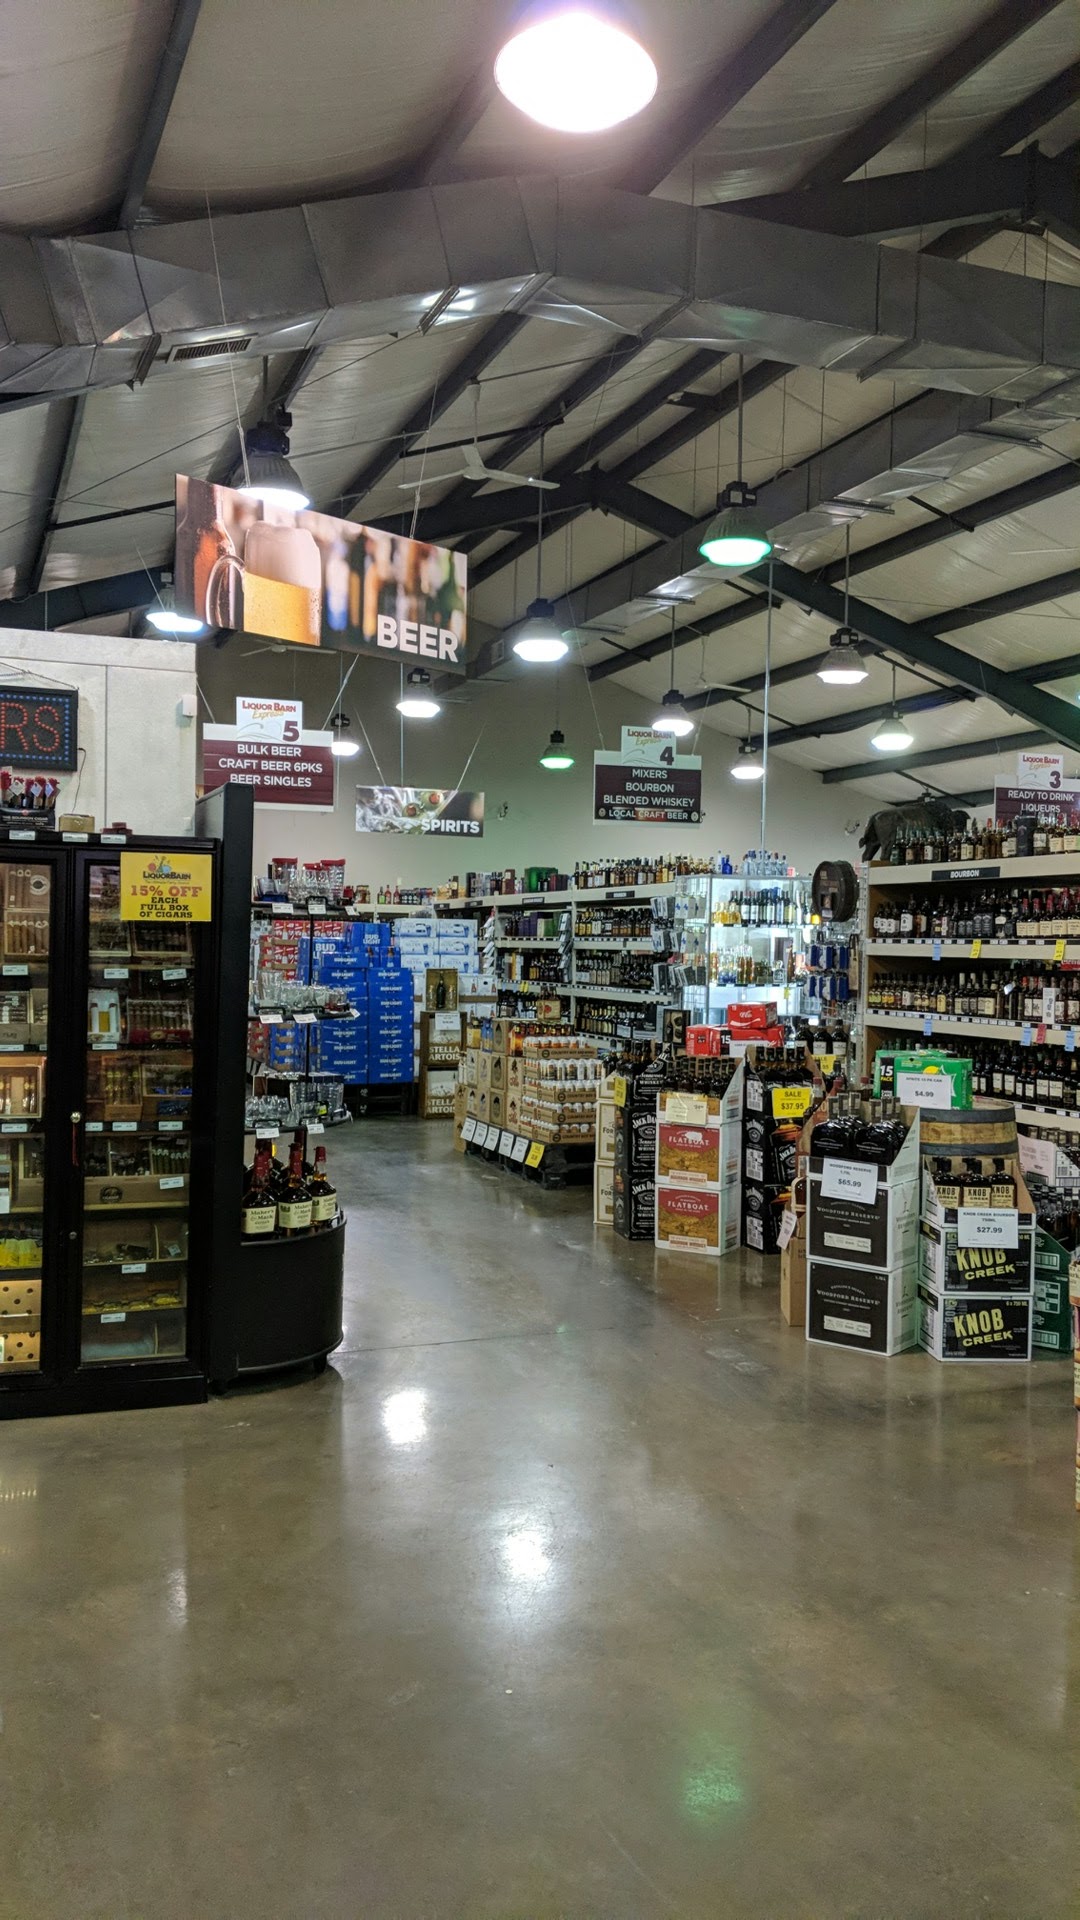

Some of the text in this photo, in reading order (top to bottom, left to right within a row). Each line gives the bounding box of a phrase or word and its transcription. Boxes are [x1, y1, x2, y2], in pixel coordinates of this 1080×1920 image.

[376, 614, 458, 662] BEER
[242, 700, 296, 712] LIQUOR BARN
[282, 720, 300, 742] 5
[237, 744, 302, 757] BULK BEER
[660, 746, 674, 766] 4
[218, 758, 322, 774] CRAFT BEER 6PKS
[632, 769, 668, 779] MIXERS
[1049, 770, 1061, 789] 3
[230, 774, 312, 788] BEER SINGLES
[626, 782, 674, 792] BOURBON
[603, 794, 695, 808] BLENDED WHISKEY
[1008, 790, 1074, 802] READY TO DRINK
[608, 809, 688, 820] LOCAL CRAFT BEER
[1021, 803, 1061, 813] LIQUEURS
[420, 818, 480, 834] SPIRITS
[950, 870, 980, 878] BOURBON
[131, 885, 202, 898] 15% OFF
[315, 943, 336, 952] BUD
[720, 1035, 731, 1044] 15
[880, 1065, 893, 1076] 15
[632, 1118, 647, 1129] JACK
[838, 1178, 862, 1188] $65.99
[632, 1186, 646, 1196] JACK
[937, 1187, 956, 1195] KNOB
[667, 1201, 709, 1211] FLATBOAT
[816, 1206, 850, 1216] WOODFORD
[850, 1211, 880, 1220] RESERVE
[955, 1248, 1007, 1271] KNOB
[964, 1263, 1016, 1280] CREEK
[816, 1289, 849, 1300] WOODFORD
[850, 1296, 880, 1305] RESERVE
[953, 1308, 1004, 1338] KNOB
[962, 1330, 1014, 1347] CREEK
